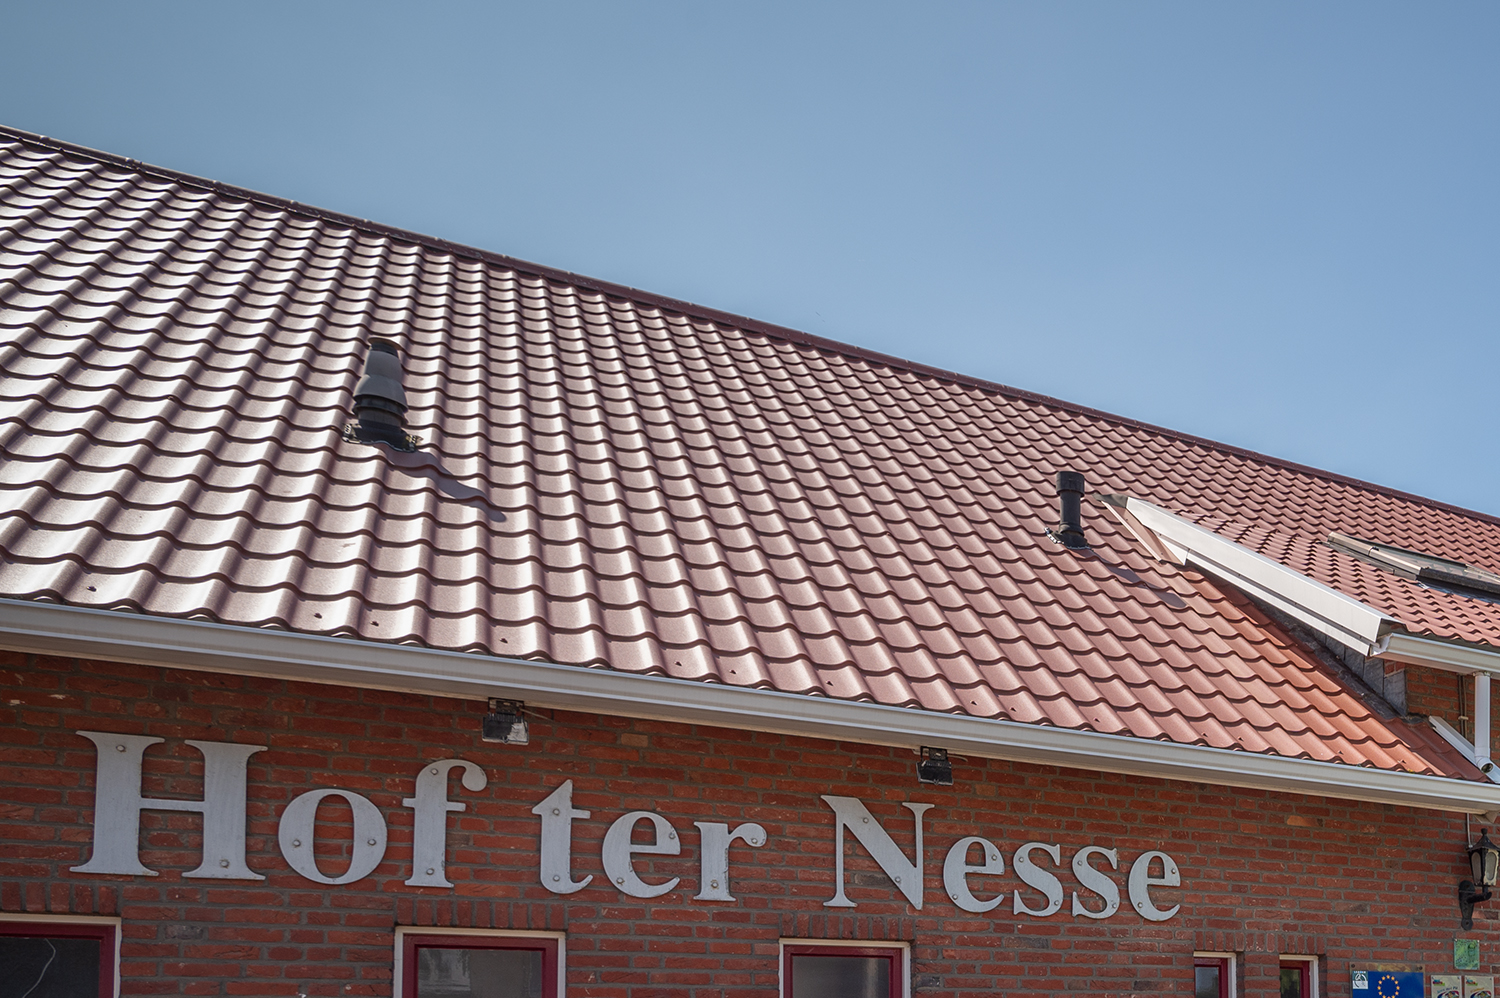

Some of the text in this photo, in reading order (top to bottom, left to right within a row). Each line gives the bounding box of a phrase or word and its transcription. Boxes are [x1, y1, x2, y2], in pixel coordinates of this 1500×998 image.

[69, 730, 1182, 922] Hof ter Nesse
